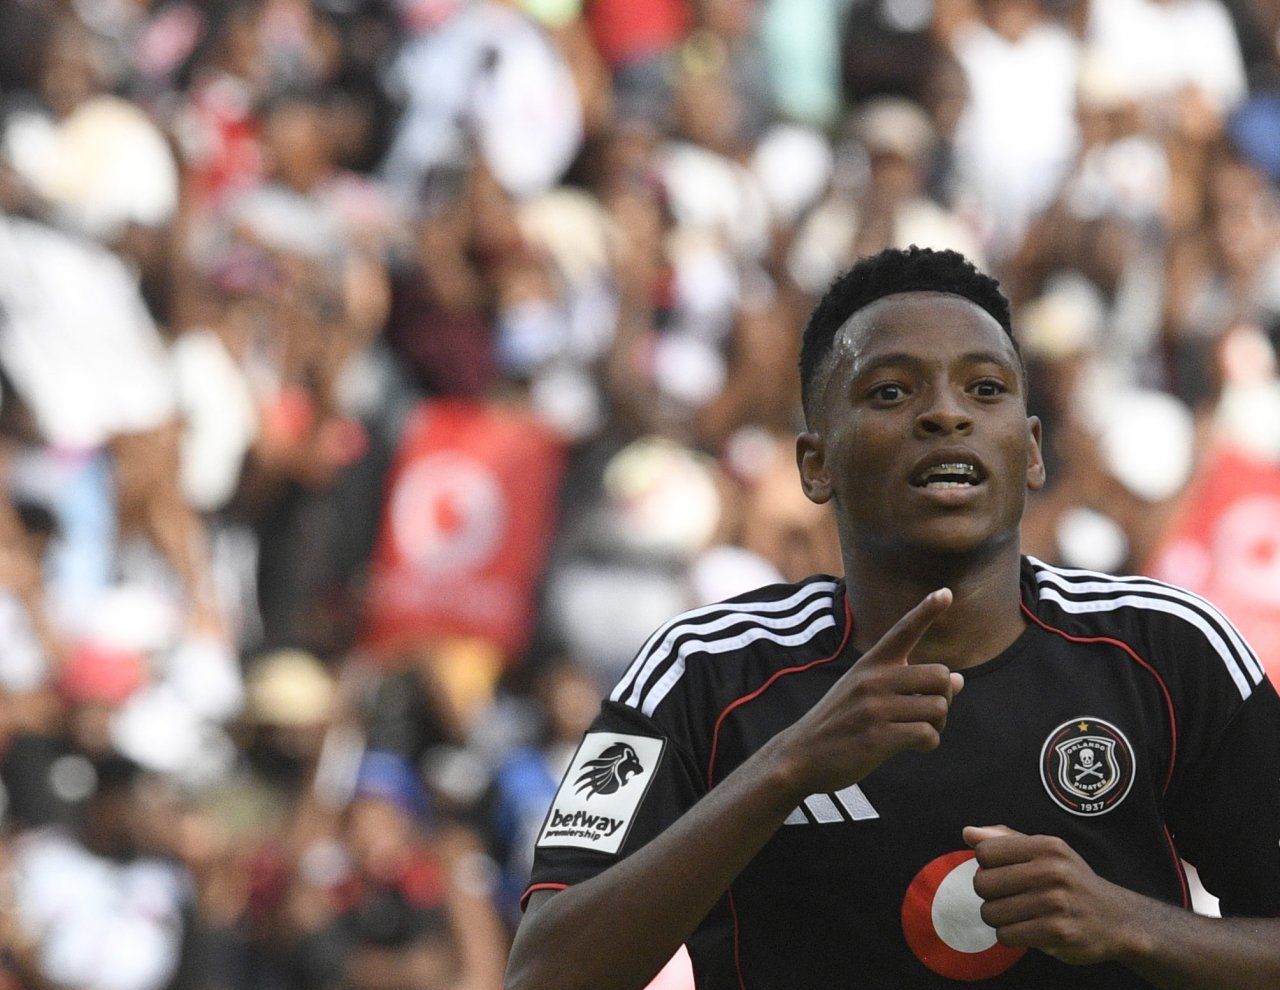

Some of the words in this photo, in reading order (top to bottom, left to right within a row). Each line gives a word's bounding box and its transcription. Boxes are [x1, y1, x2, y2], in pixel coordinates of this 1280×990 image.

[1074, 779, 1107, 791] PIRATES
[1080, 801, 1105, 812] 1937
[550, 809, 624, 837] betway
[544, 827, 601, 841] premiership
